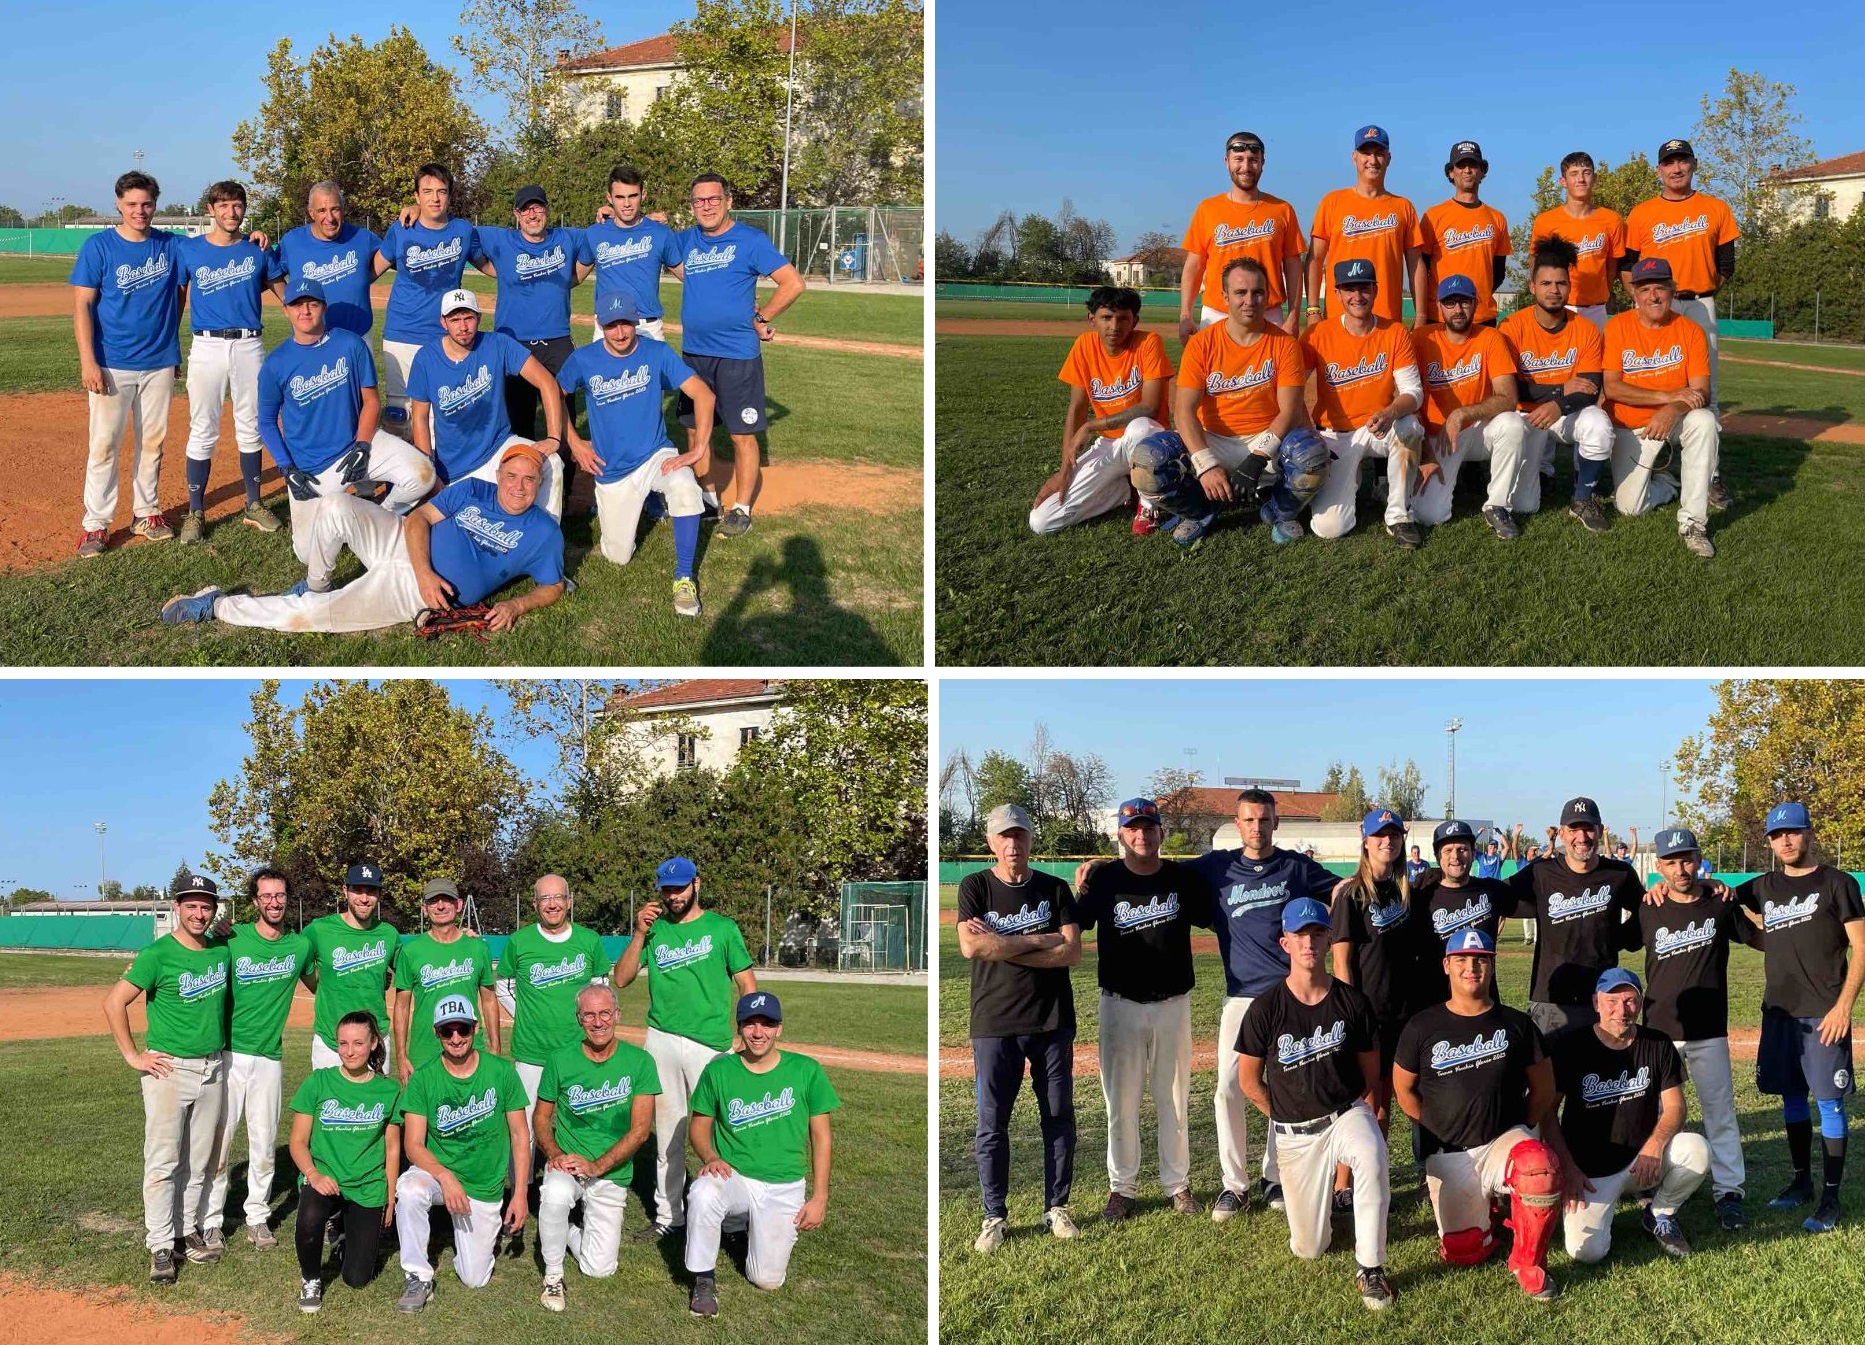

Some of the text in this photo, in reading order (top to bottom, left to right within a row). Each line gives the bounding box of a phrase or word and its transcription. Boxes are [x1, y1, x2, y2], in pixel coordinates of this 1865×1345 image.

[1215, 219, 1275, 242] Baseball
[1343, 213, 1398, 233] Baseball
[1445, 224, 1494, 246] Baseball
[1653, 215, 1709, 239] Baseball
[407, 237, 462, 266] Baseball
[516, 246, 565, 271] Baseball
[597, 236, 652, 261] Baseball
[688, 245, 736, 266] Baseball
[196, 256, 255, 288] Baseball
[303, 250, 358, 280] Baseball
[1347, 262, 1364, 277] M
[297, 281, 310, 292] M
[454, 292, 465, 301] NY
[609, 297, 623, 310] M
[1326, 352, 1387, 383] Baseball
[1428, 353, 1481, 380] Baseball
[1520, 347, 1577, 371] Baseball
[1622, 345, 1683, 369] Baseball
[290, 357, 348, 397] Baseball
[438, 365, 492, 407] Baseball
[589, 365, 650, 396] Baseball
[1207, 359, 1274, 392] Baseball
[456, 506, 523, 548] Baseball
[1574, 801, 1586, 813] NY
[1773, 810, 1787, 822] M
[1668, 831, 1684, 848] M
[192, 877, 204, 887] NY
[361, 866, 373, 878] LA
[1114, 893, 1180, 924] Baseball
[1299, 905, 1315, 918] M
[1433, 893, 1492, 928] Baseball
[1548, 885, 1611, 913] Baseball
[1765, 893, 1820, 922] Baseball
[984, 900, 1051, 930] Baseball
[1462, 931, 1485, 949] A
[1655, 918, 1716, 949] Baseball
[333, 940, 387, 966] Baseball
[655, 935, 712, 964] Baseball
[236, 954, 296, 975] Baseball
[421, 958, 474, 983] Baseball
[530, 954, 586, 982] Baseball
[179, 962, 226, 994] Baseball
[440, 1000, 466, 1016] TBA
[750, 995, 766, 1009] M
[1278, 1020, 1347, 1060] Baseball
[1431, 1029, 1509, 1064] Baseball
[569, 1076, 632, 1106] Baseball
[1582, 1066, 1650, 1096] Baseball
[320, 1099, 385, 1121] Baseball
[437, 1087, 497, 1127] Baseball
[729, 1087, 795, 1121] Baseball
